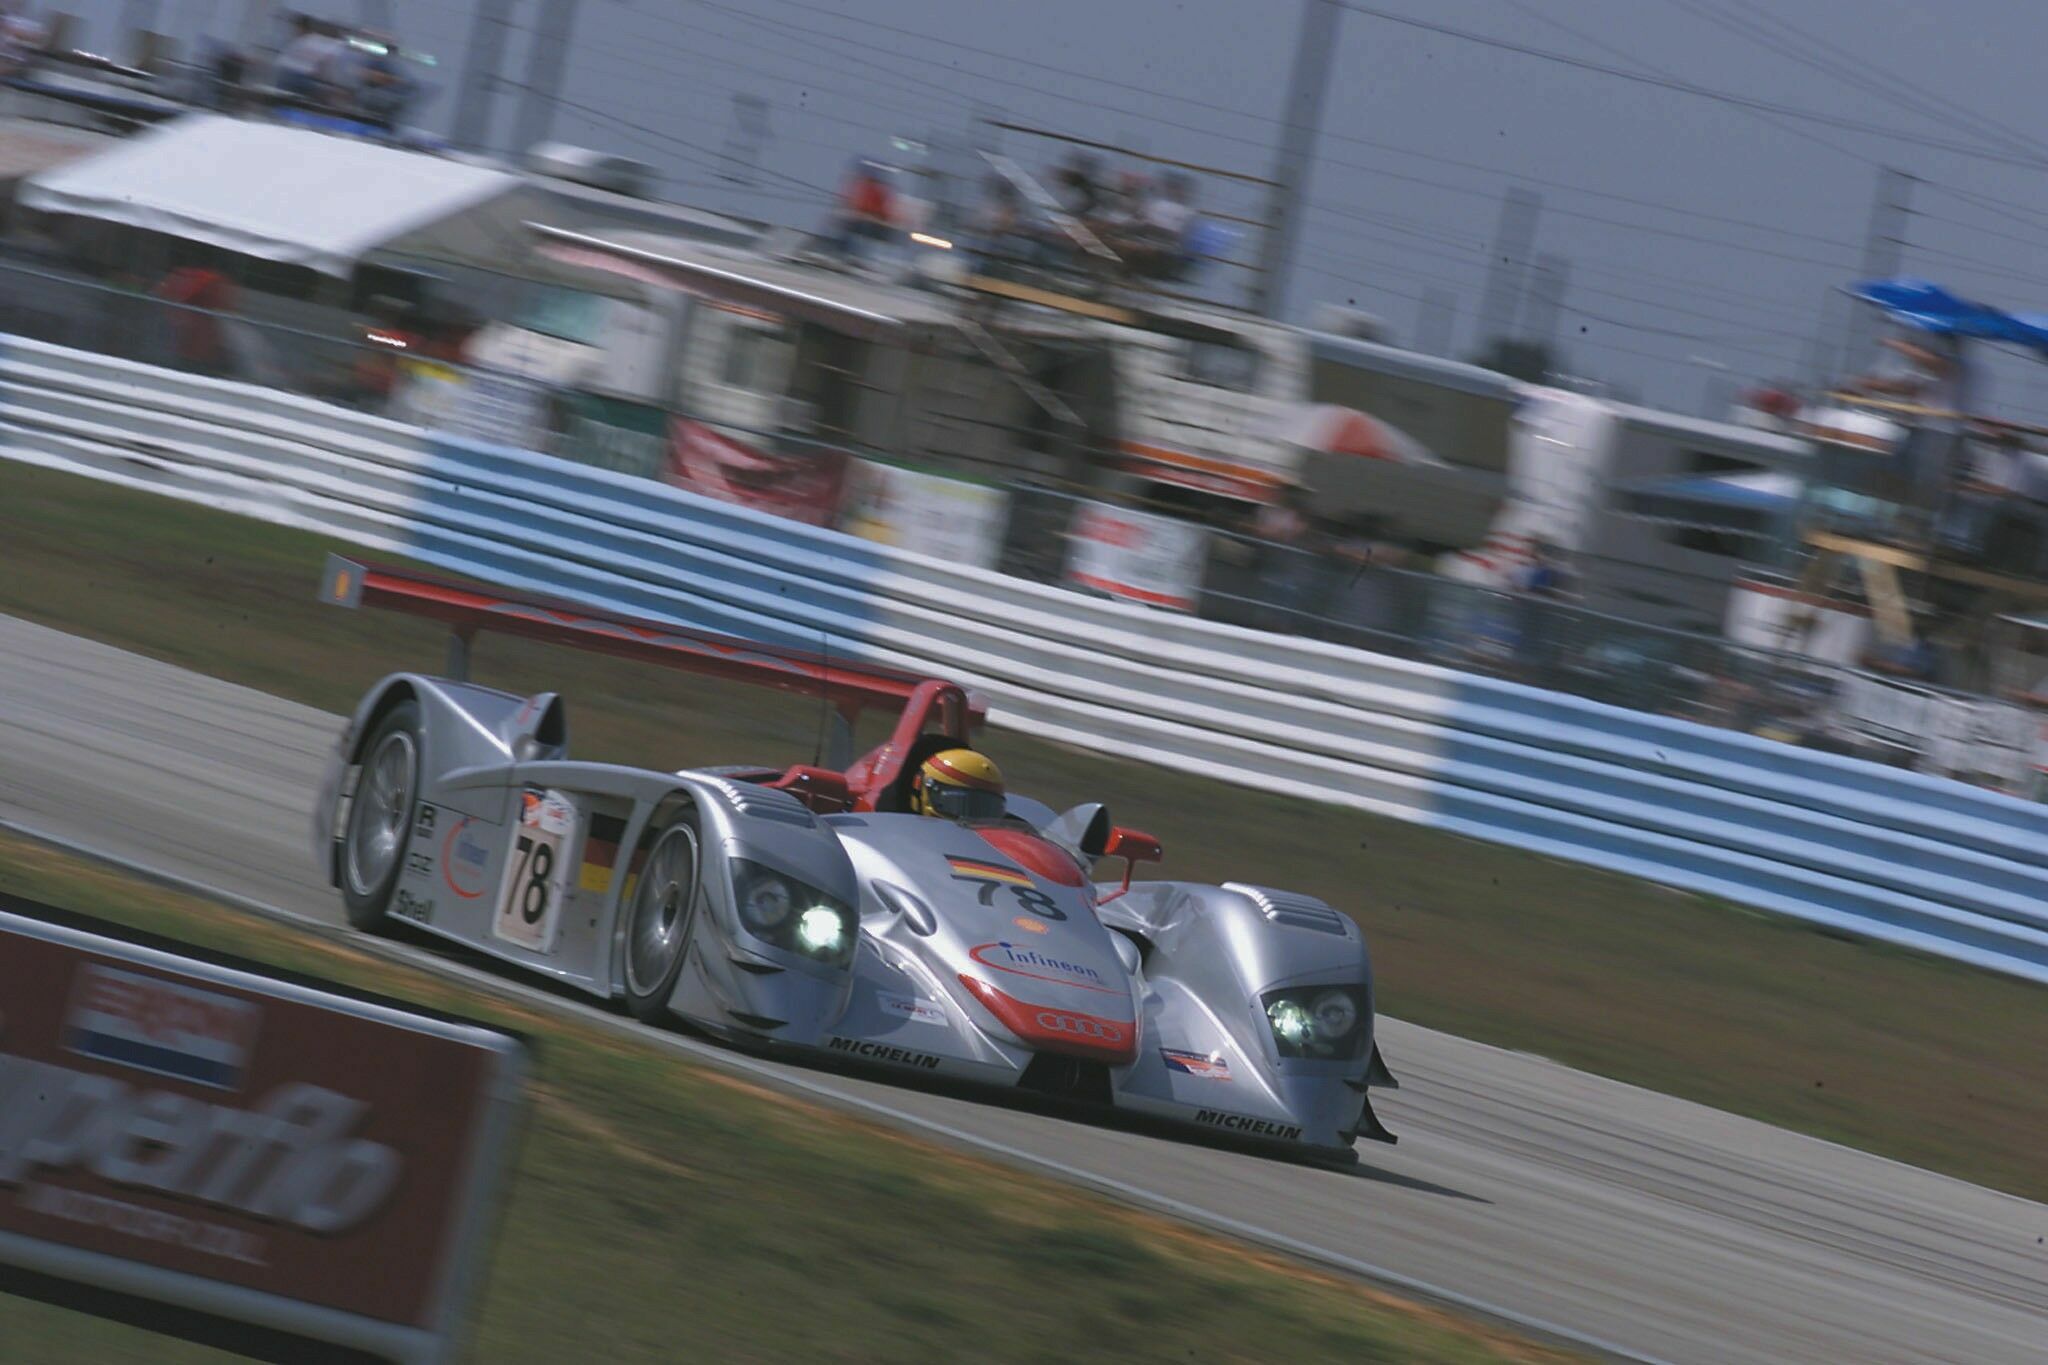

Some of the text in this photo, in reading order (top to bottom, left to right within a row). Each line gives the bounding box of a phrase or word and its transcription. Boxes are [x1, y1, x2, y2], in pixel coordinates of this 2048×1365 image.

[505, 836, 553, 924] 78
[950, 873, 1067, 921] 78
[828, 1036, 941, 1070] MICHELIN
[1195, 1109, 1302, 1140] MICHELIN
